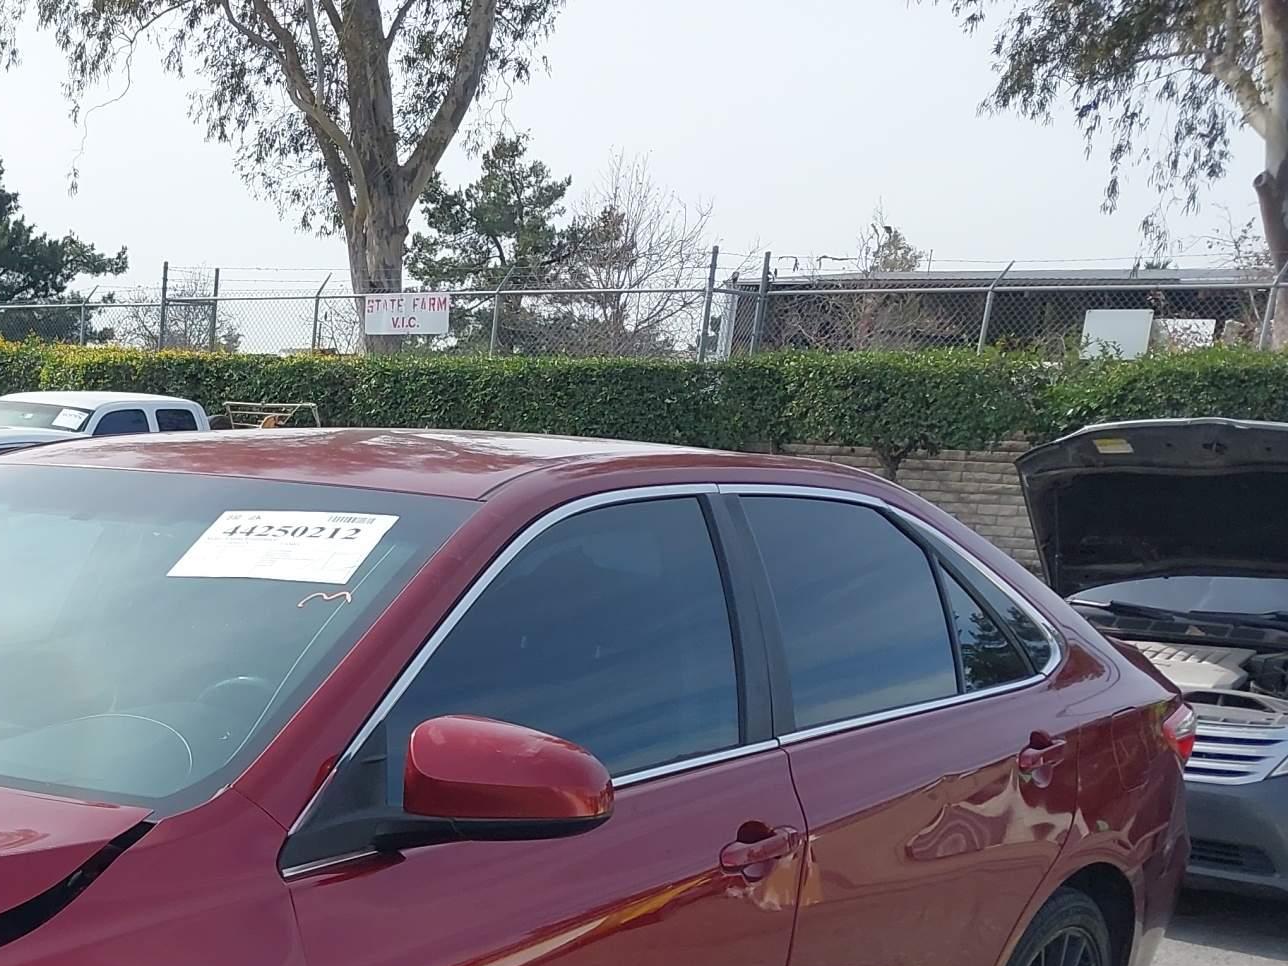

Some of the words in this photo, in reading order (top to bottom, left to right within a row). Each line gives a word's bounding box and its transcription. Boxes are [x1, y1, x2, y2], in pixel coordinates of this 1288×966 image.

[367, 298, 404, 313] STATE
[412, 297, 447, 313] FARM
[391, 316, 420, 329] V.I.C.
[222, 524, 362, 541] 44250212
